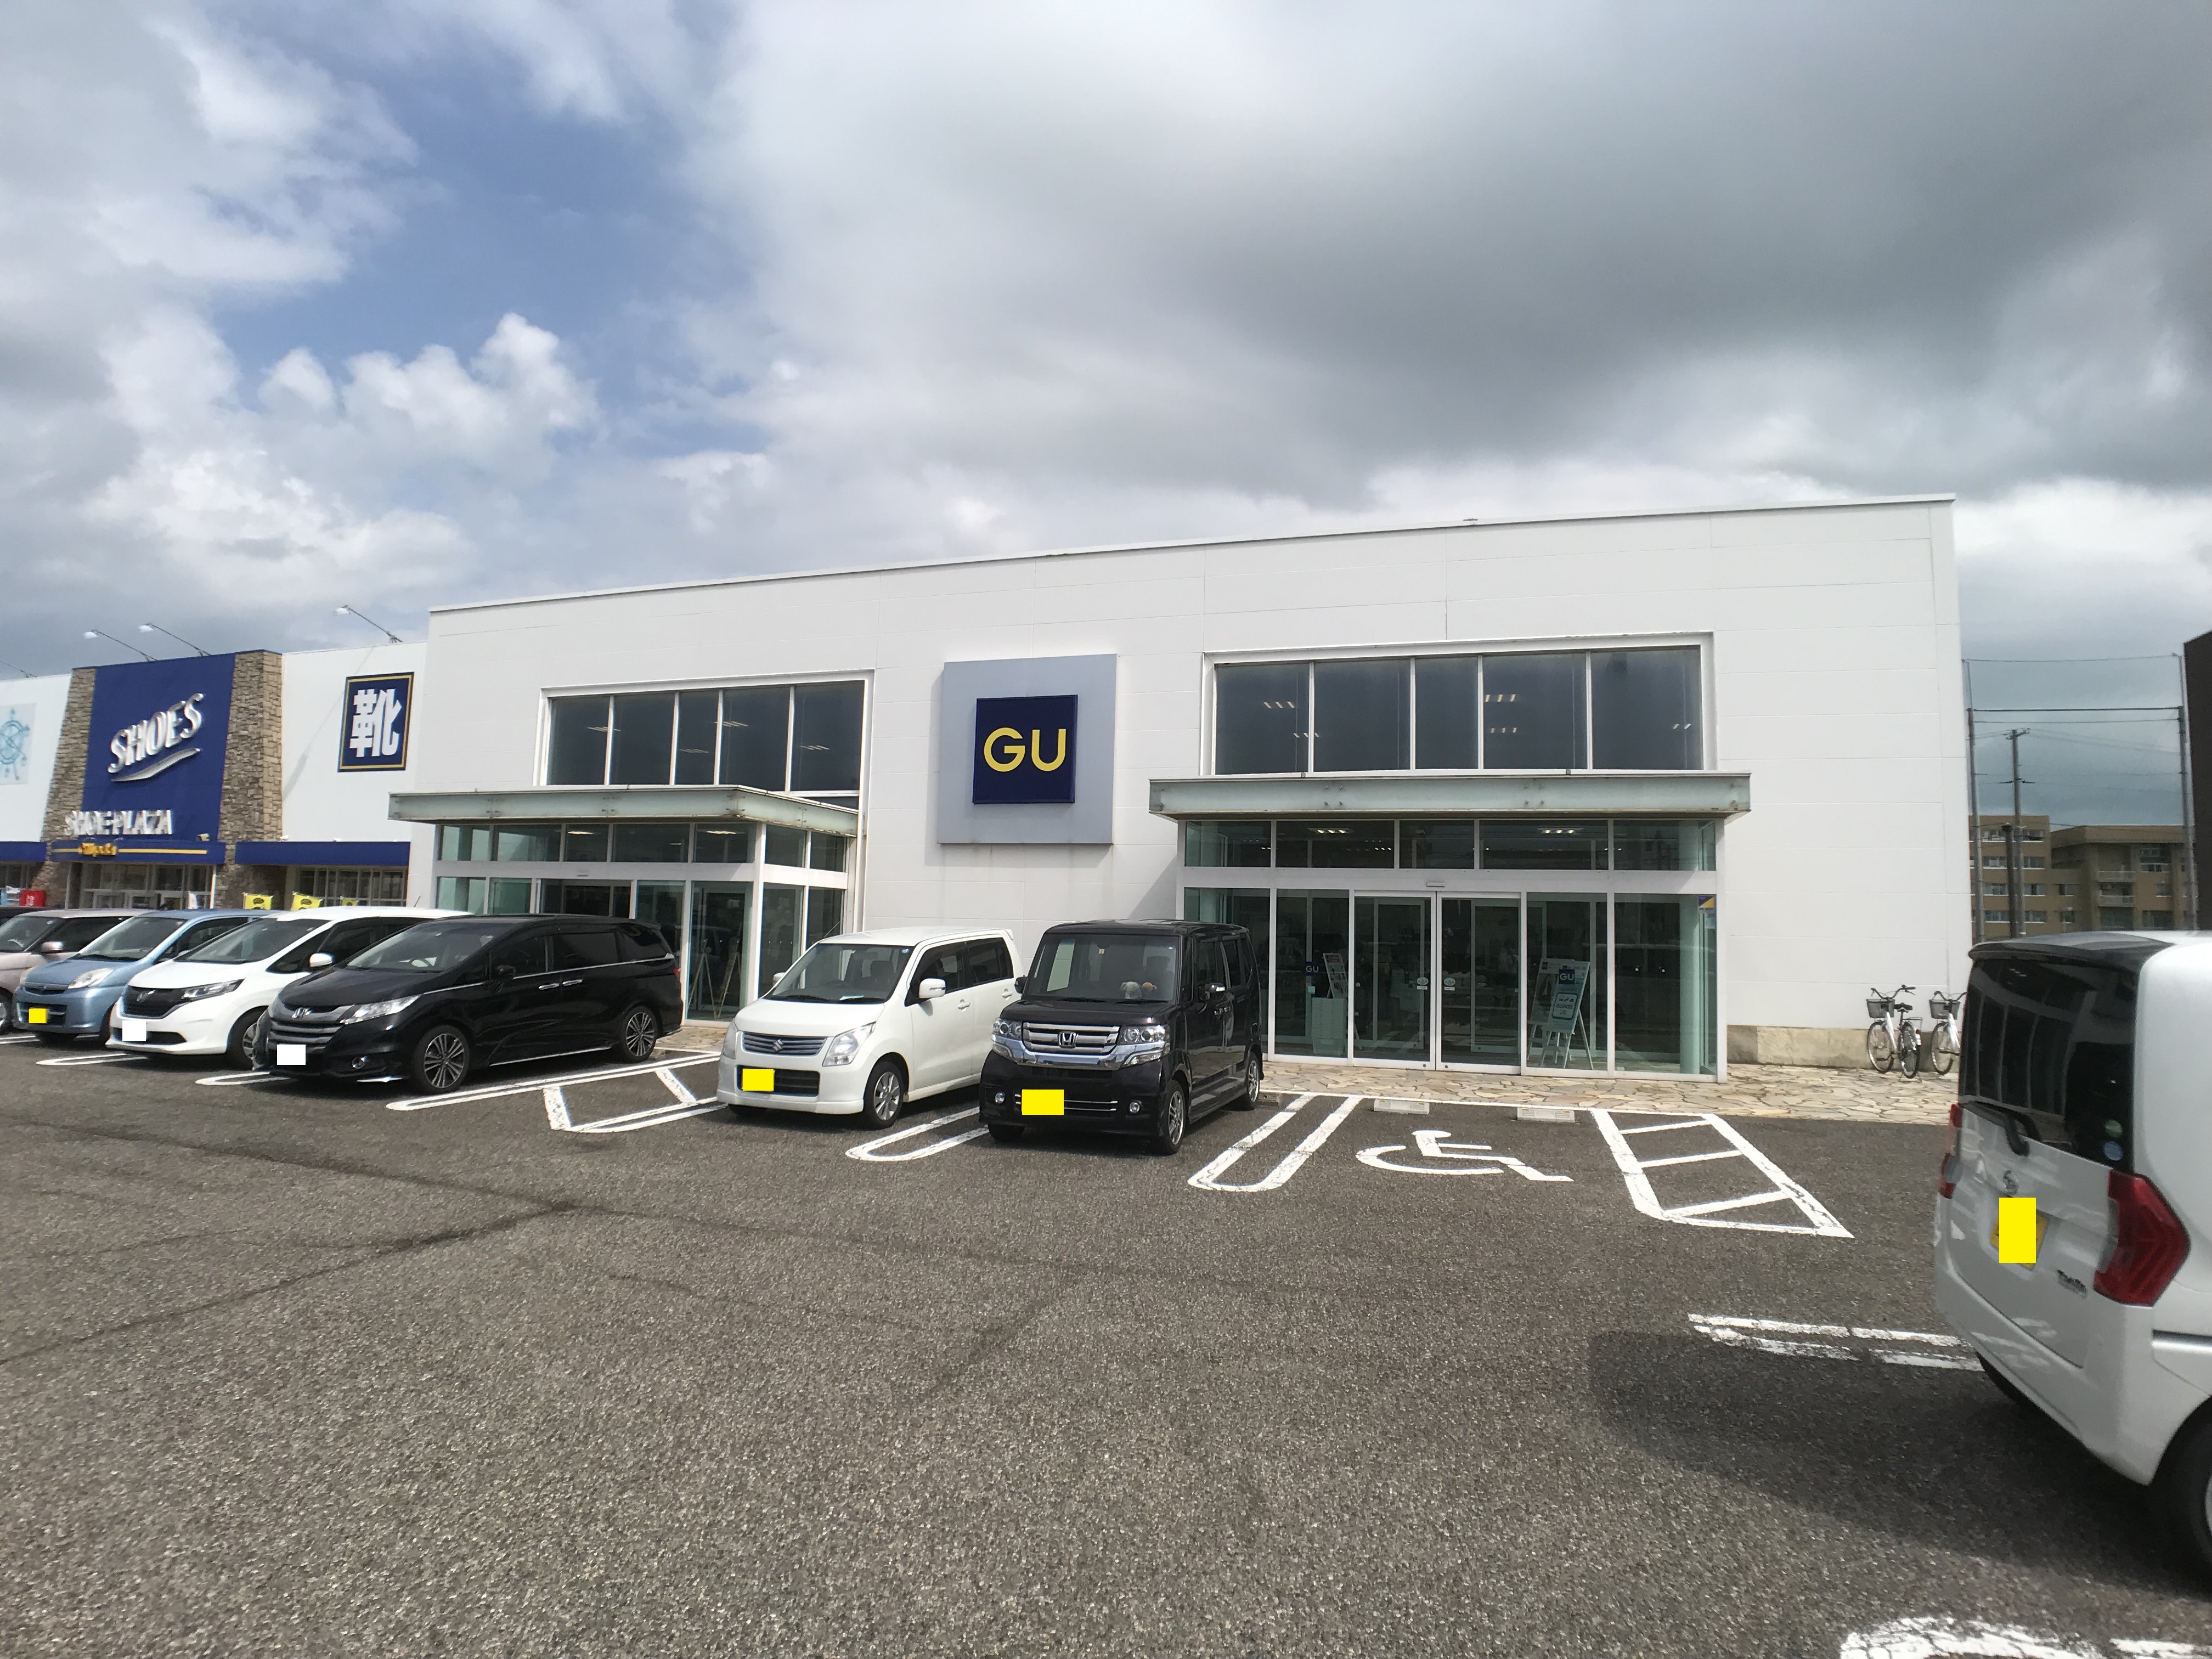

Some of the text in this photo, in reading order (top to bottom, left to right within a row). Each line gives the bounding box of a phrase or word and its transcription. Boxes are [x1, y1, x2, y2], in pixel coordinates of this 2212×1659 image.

[108, 693, 203, 774] SHOES
[349, 689, 402, 757] 靴
[984, 727, 1066, 772] GU
